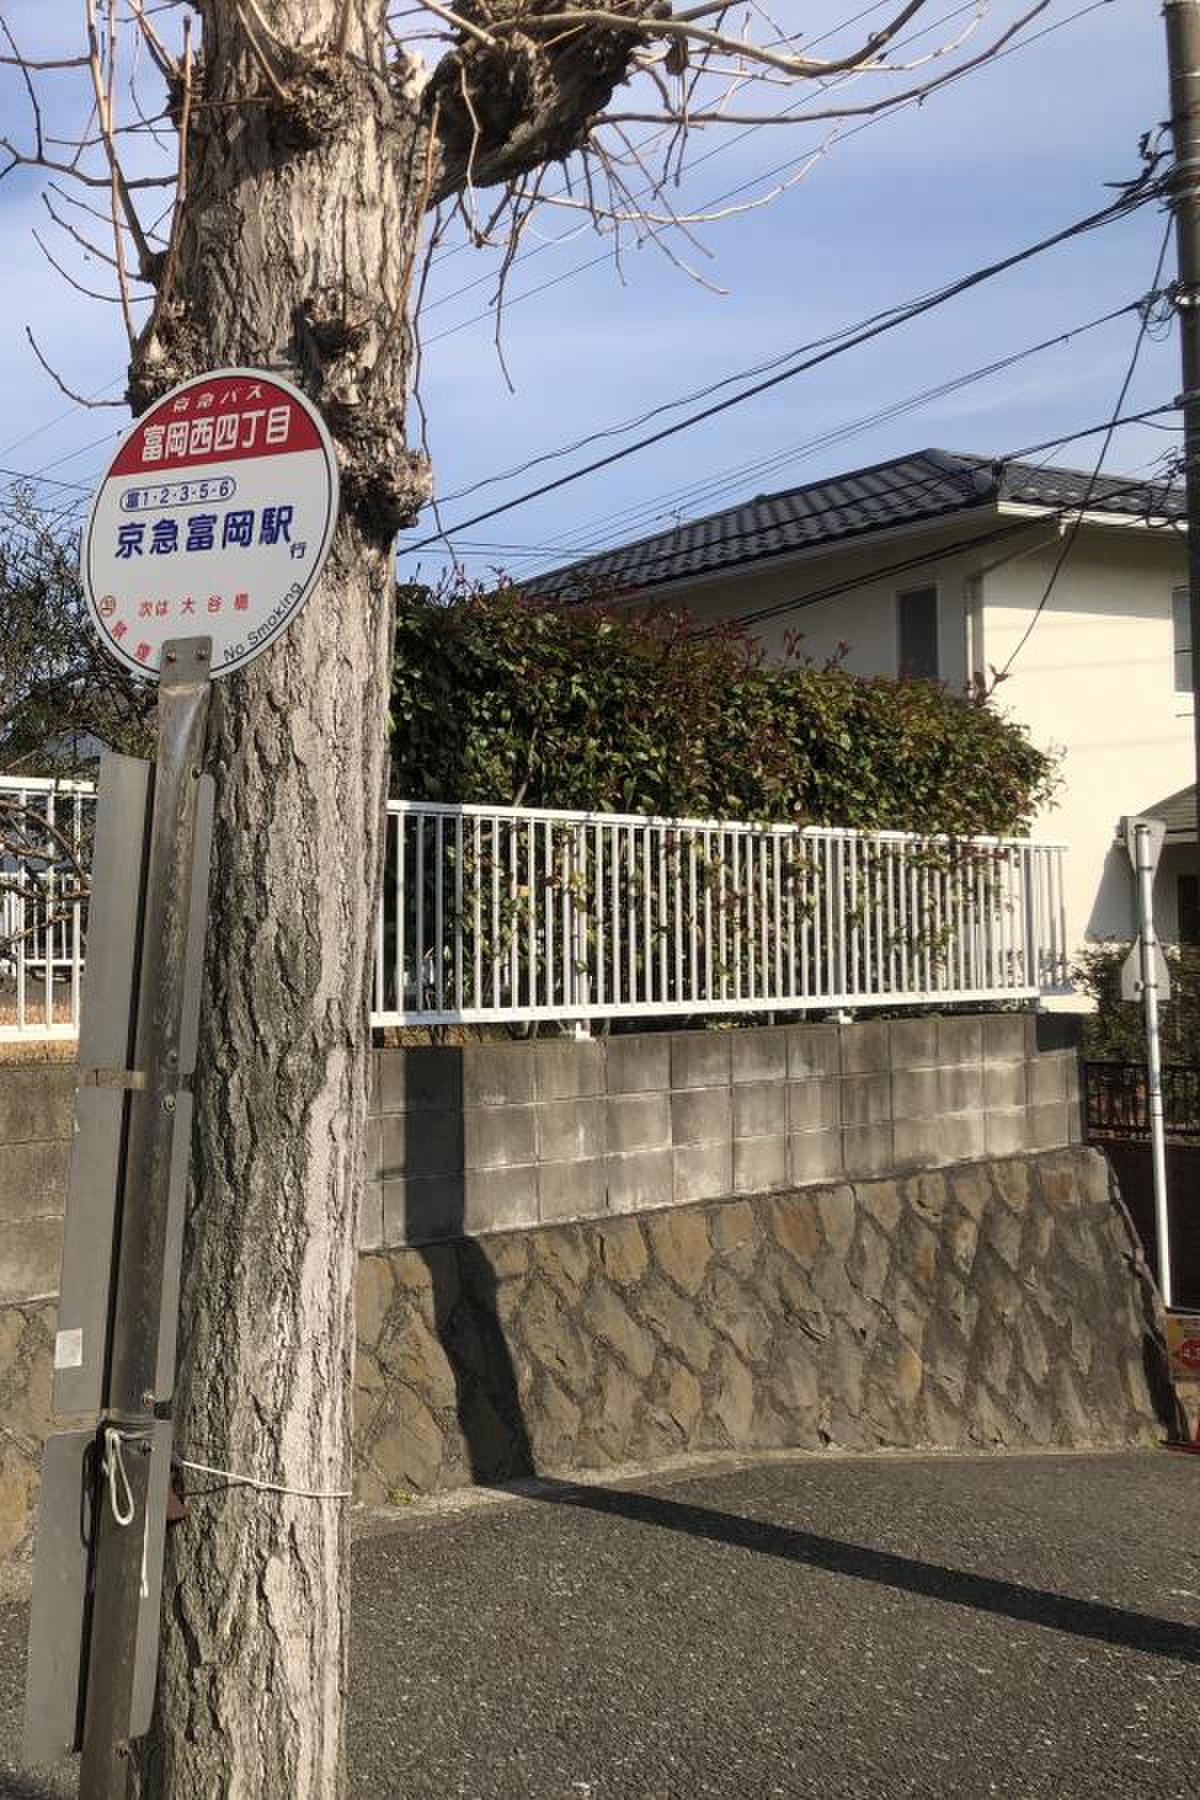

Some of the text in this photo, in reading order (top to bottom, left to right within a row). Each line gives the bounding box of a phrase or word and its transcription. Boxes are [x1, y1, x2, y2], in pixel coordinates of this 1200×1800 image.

[142, 404, 291, 462] 富岡西四丁目
[223, 581, 304, 662] No Smoking
